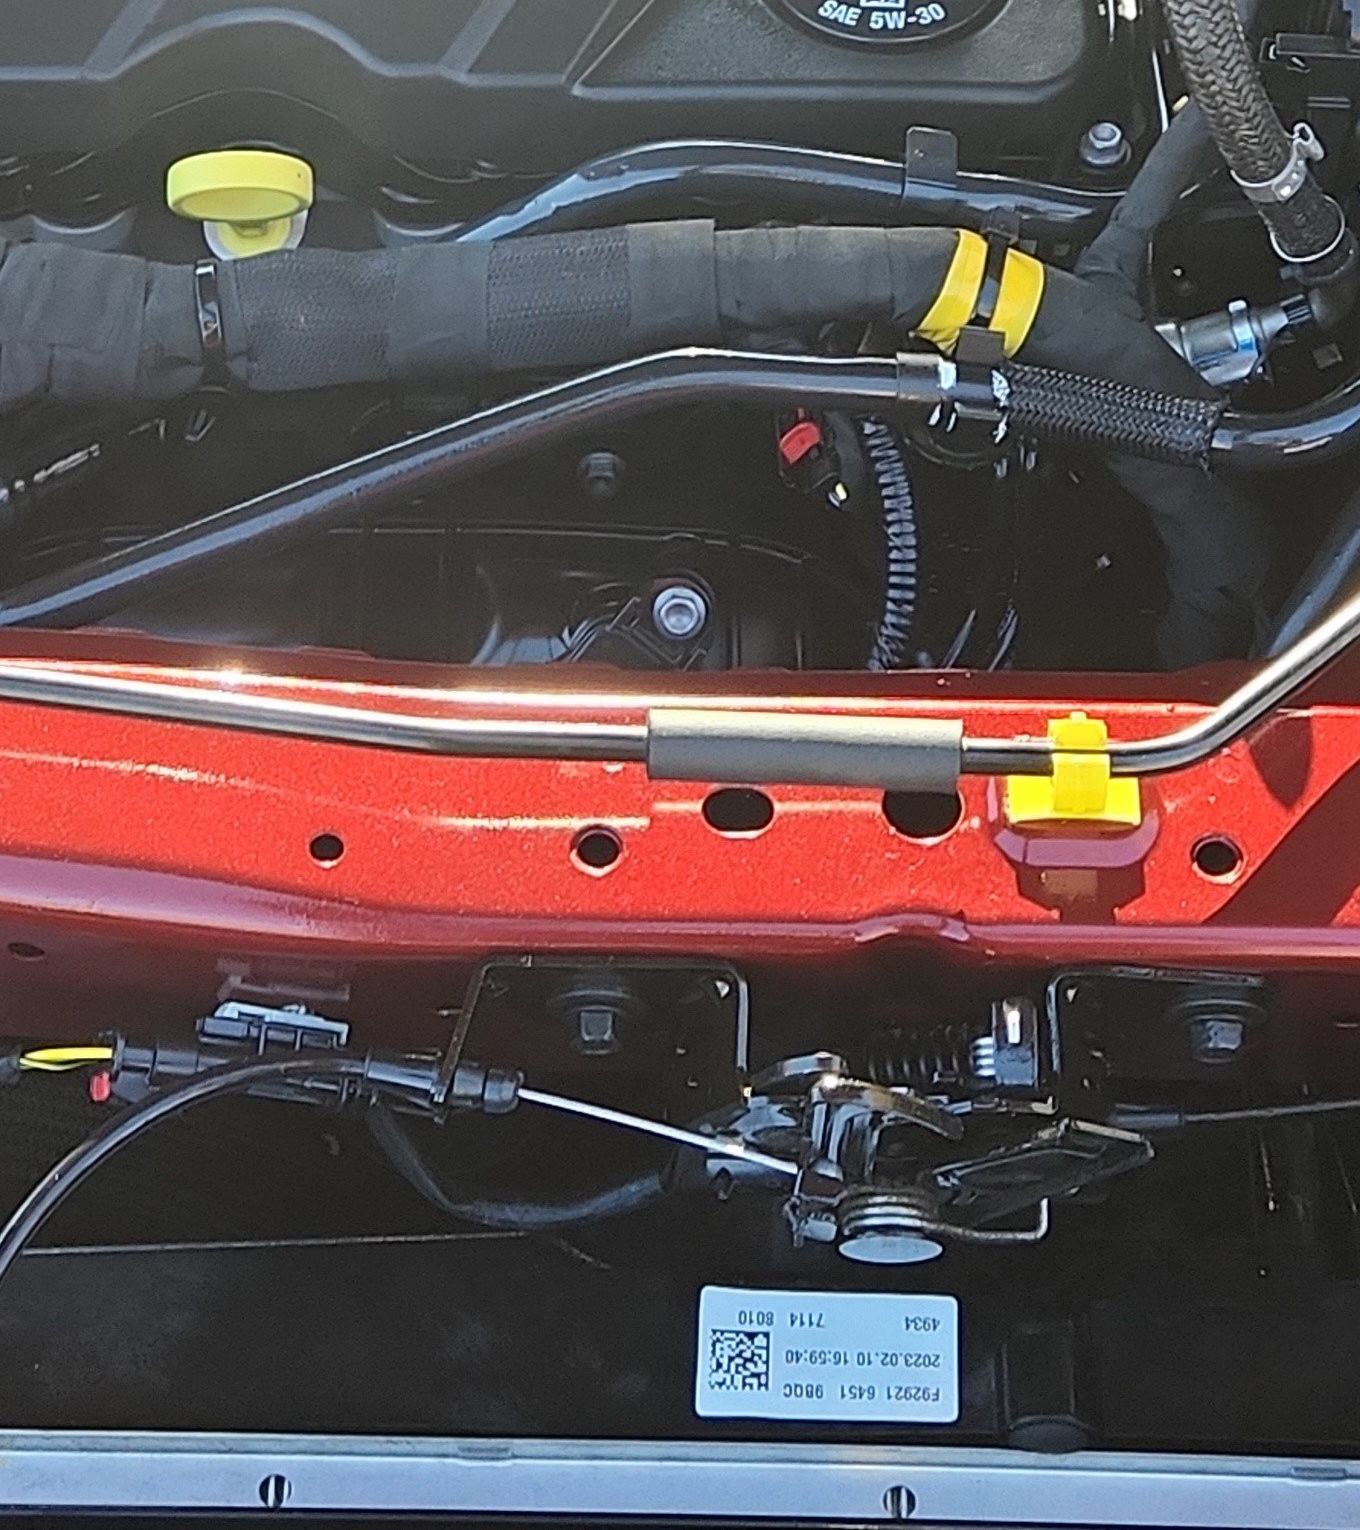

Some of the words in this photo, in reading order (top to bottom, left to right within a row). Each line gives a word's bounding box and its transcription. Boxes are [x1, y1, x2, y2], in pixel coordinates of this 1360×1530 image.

[818, 0, 861, 26] SAE
[868, 2, 946, 30] 5W-30
[738, 1310, 774, 1325] 8010
[790, 1312, 825, 1328] 7114
[905, 1316, 940, 1331] 4934
[857, 1351, 941, 1367] 2023.02.10
[840, 1384, 876, 1400] 6451
[886, 1384, 940, 1402] F92921
